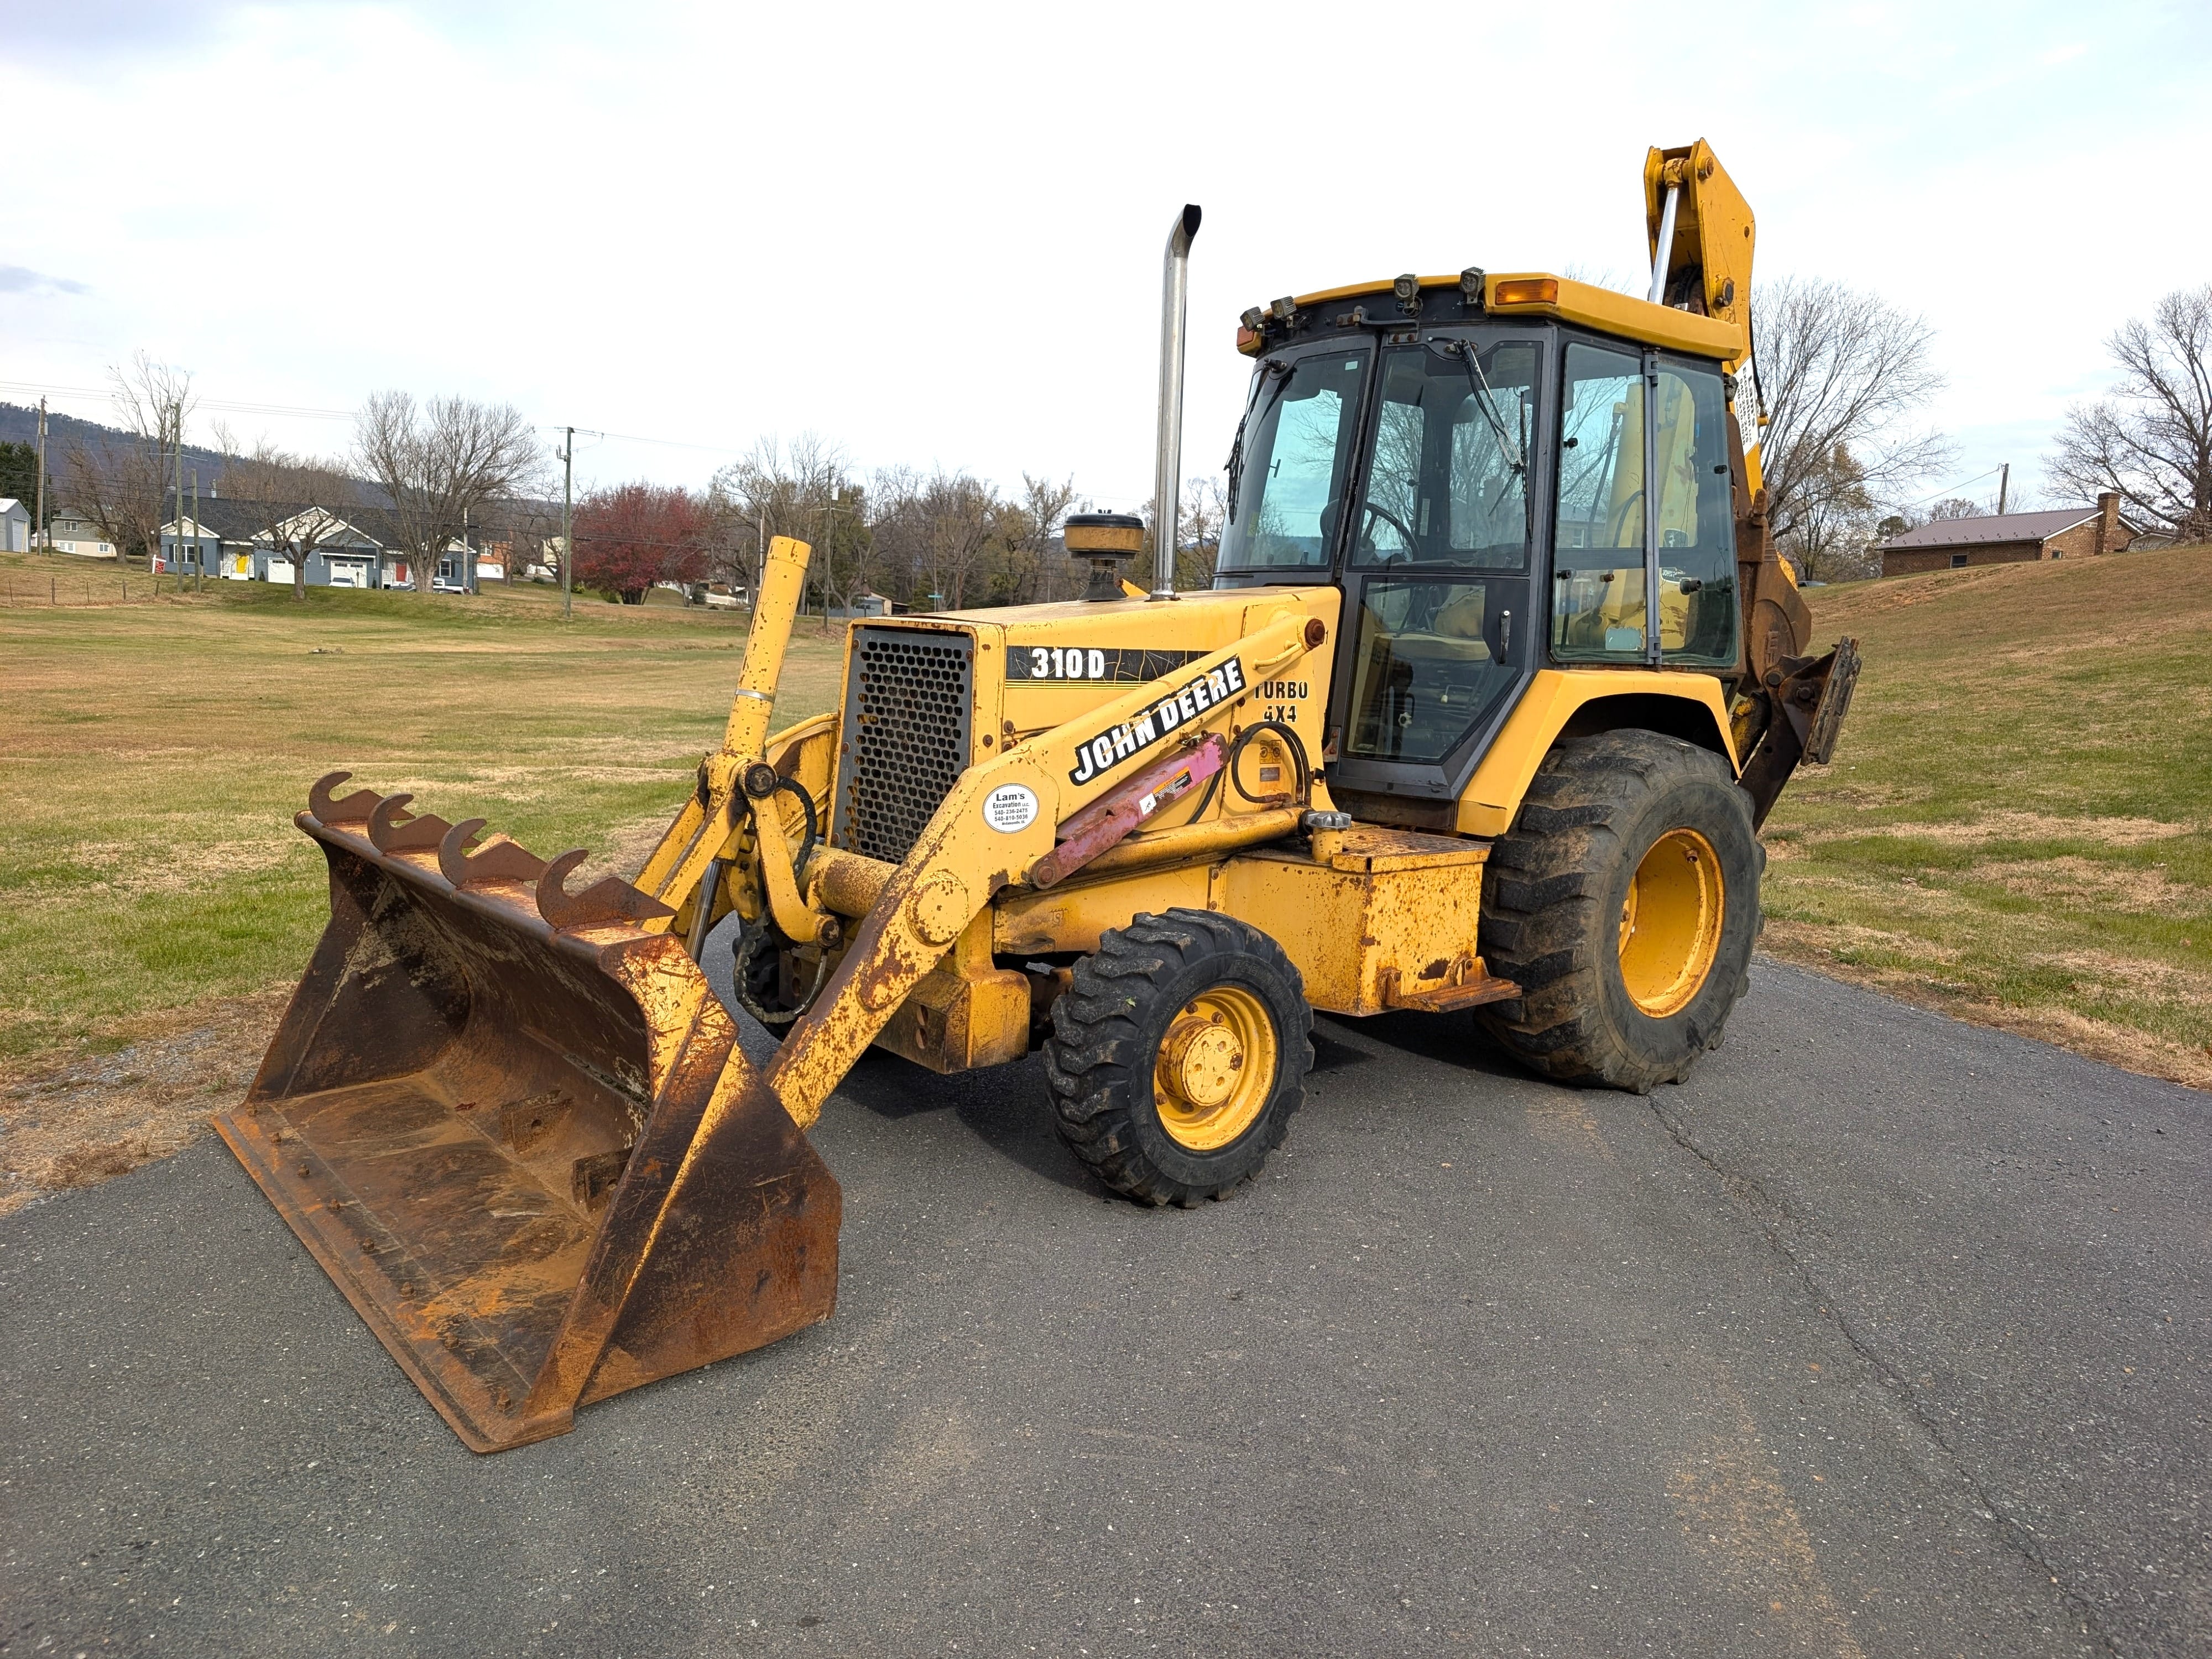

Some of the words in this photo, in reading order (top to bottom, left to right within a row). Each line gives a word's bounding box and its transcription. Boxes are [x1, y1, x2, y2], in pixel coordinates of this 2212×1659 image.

[1743, 366, 1751, 426] Excavation
[1255, 681, 1308, 699] TURBO
[1074, 710, 1156, 781] JOHN
[1157, 659, 1242, 731] DEERE
[1264, 705, 1296, 722] 4X4
[996, 792, 1025, 801] Lam's
